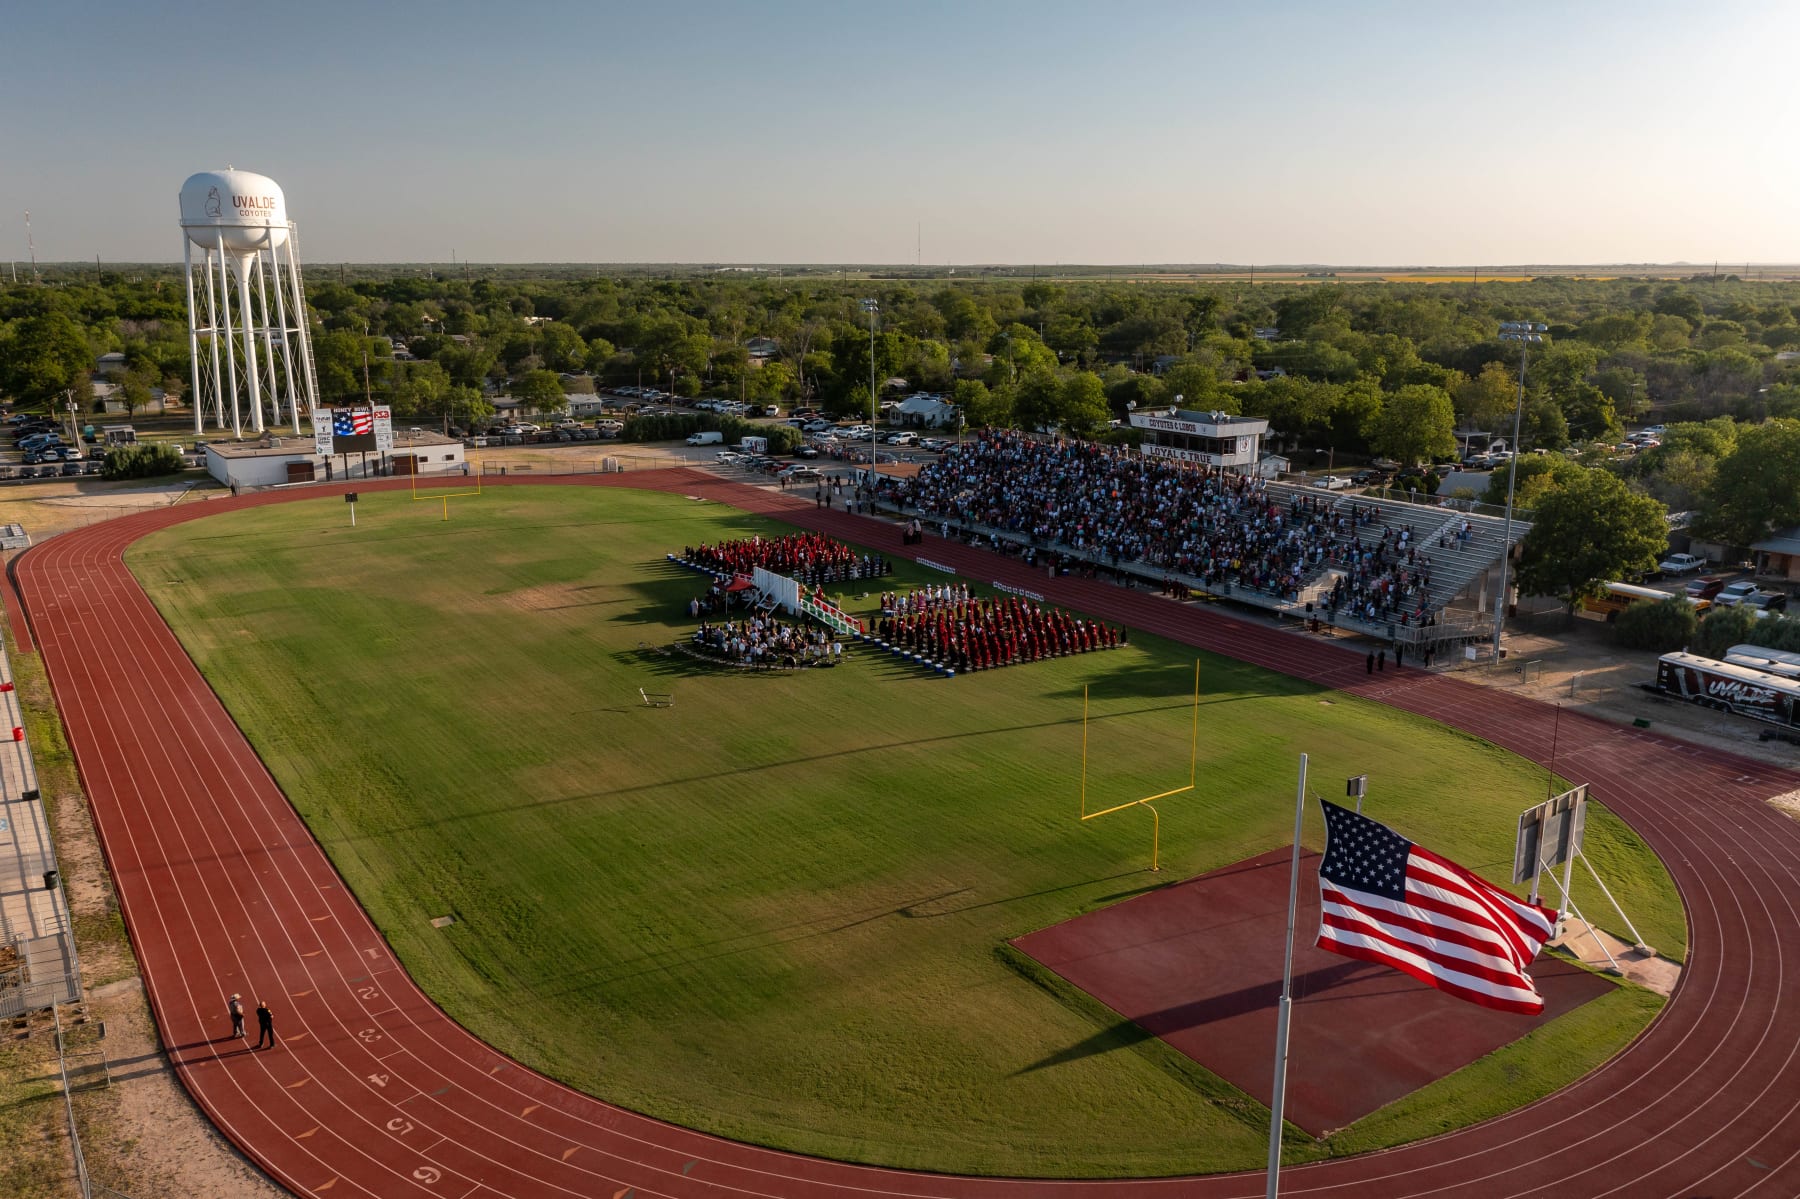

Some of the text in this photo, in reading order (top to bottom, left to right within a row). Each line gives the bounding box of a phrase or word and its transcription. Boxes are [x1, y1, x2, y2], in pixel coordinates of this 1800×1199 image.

[232, 196, 275, 209] UVALDE
[1149, 418, 1174, 430] COYOTES
[1179, 421, 1197, 432] LOBOS
[1150, 447, 1178, 459] LOYAL
[1188, 453, 1212, 464] TRUE
[1708, 680, 1777, 704] UVALDE
